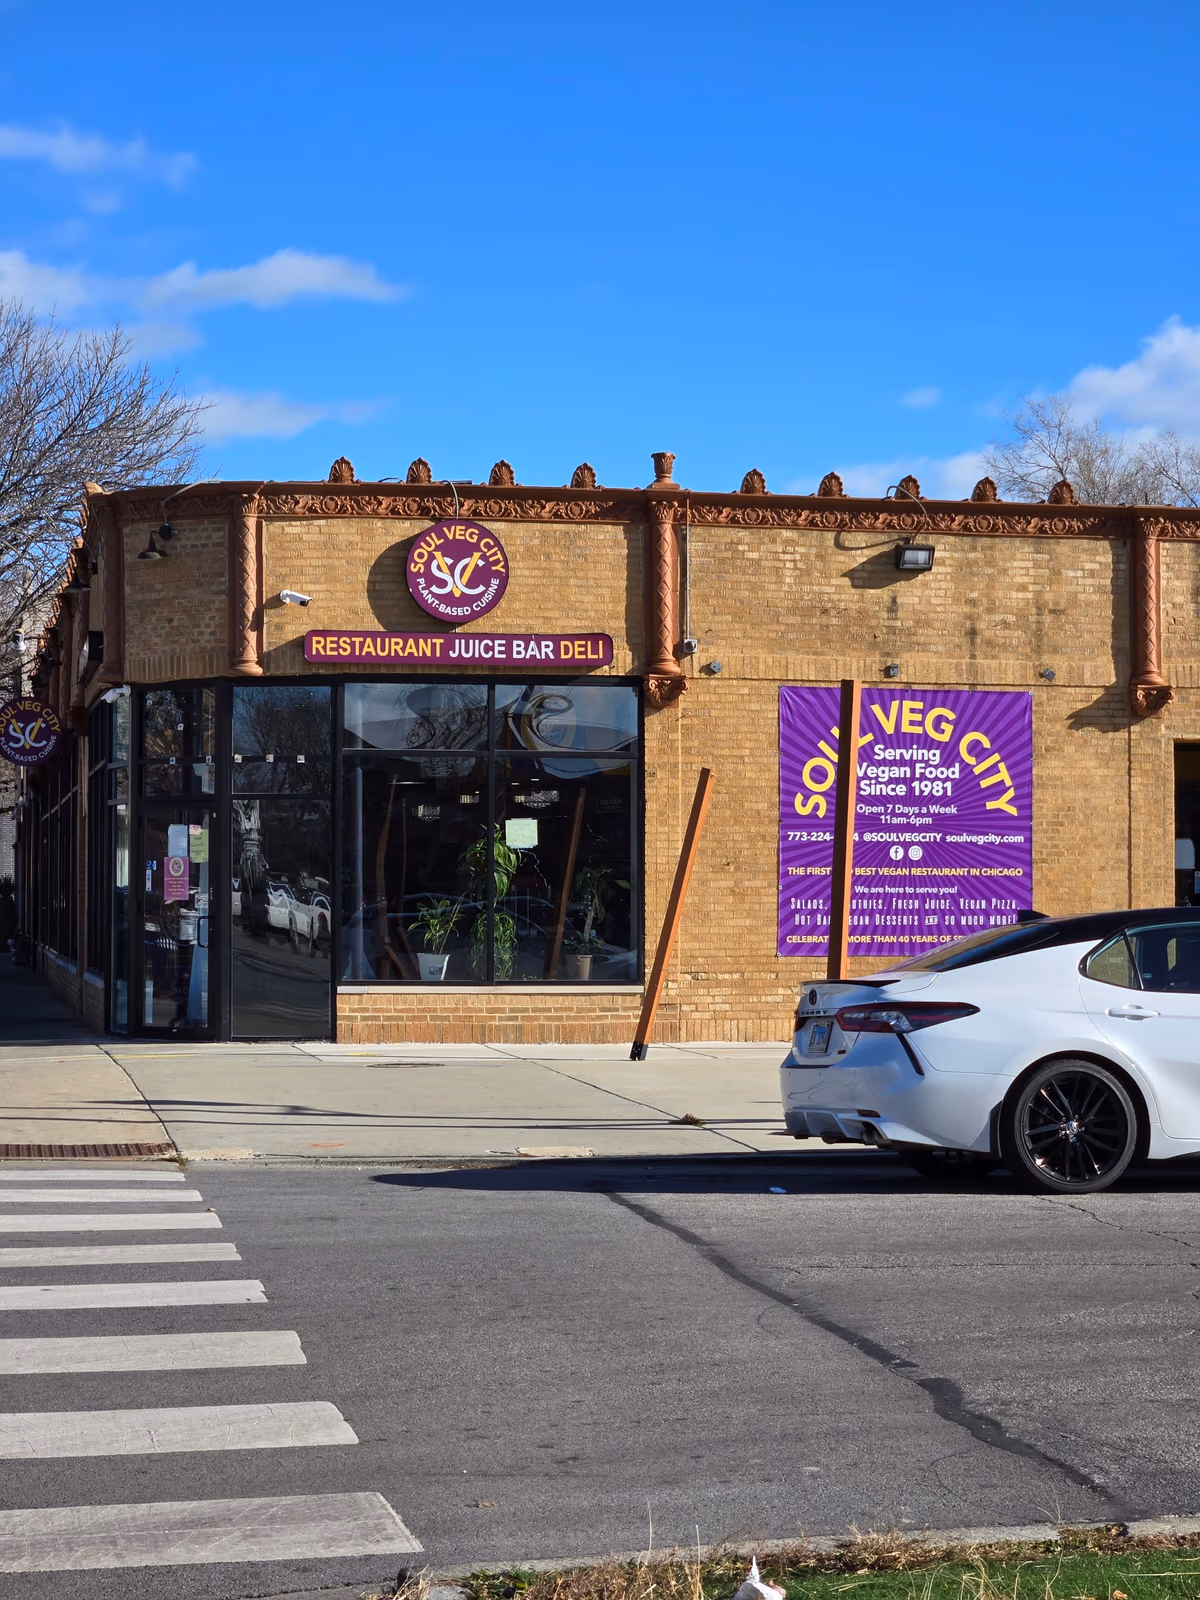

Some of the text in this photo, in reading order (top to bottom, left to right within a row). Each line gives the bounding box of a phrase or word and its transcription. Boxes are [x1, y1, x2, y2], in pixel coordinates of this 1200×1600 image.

[410, 526, 506, 574] SOUL VEG CITY
[416, 578, 500, 616] PLANT-BASED CUISINE
[312, 636, 603, 659] RESTAURANT JUICE BAR DELI
[16, 700, 42, 712] VEG
[42, 708, 60, 732] CITY
[38, 735, 56, 758] CUISINE
[874, 744, 940, 764] Serving
[870, 700, 956, 742] VEG
[959, 731, 1018, 816] CITY
[856, 762, 960, 782] Vegan Food
[860, 780, 952, 796] Since 1981
[856, 804, 884, 816] Open
[886, 804, 893, 812] 7
[896, 804, 919, 816] Days
[928, 804, 958, 814] Week
[880, 816, 932, 826] 11am-6pm
[863, 832, 942, 842] @SOULVEGCITY
[946, 833, 1024, 844] soulvegcity.com
[788, 867, 832, 876] THE FIRST
[854, 868, 876, 876] BEST
[878, 868, 909, 876] VEGAN
[911, 868, 968, 876] RESTAURANT
[970, 868, 980, 876] IN
[981, 868, 1024, 876] CHICAGO
[854, 886, 868, 894] We
[886, 885, 904, 894] here
[939, 886, 958, 896] you!
[848, 915, 870, 926] EGAN
